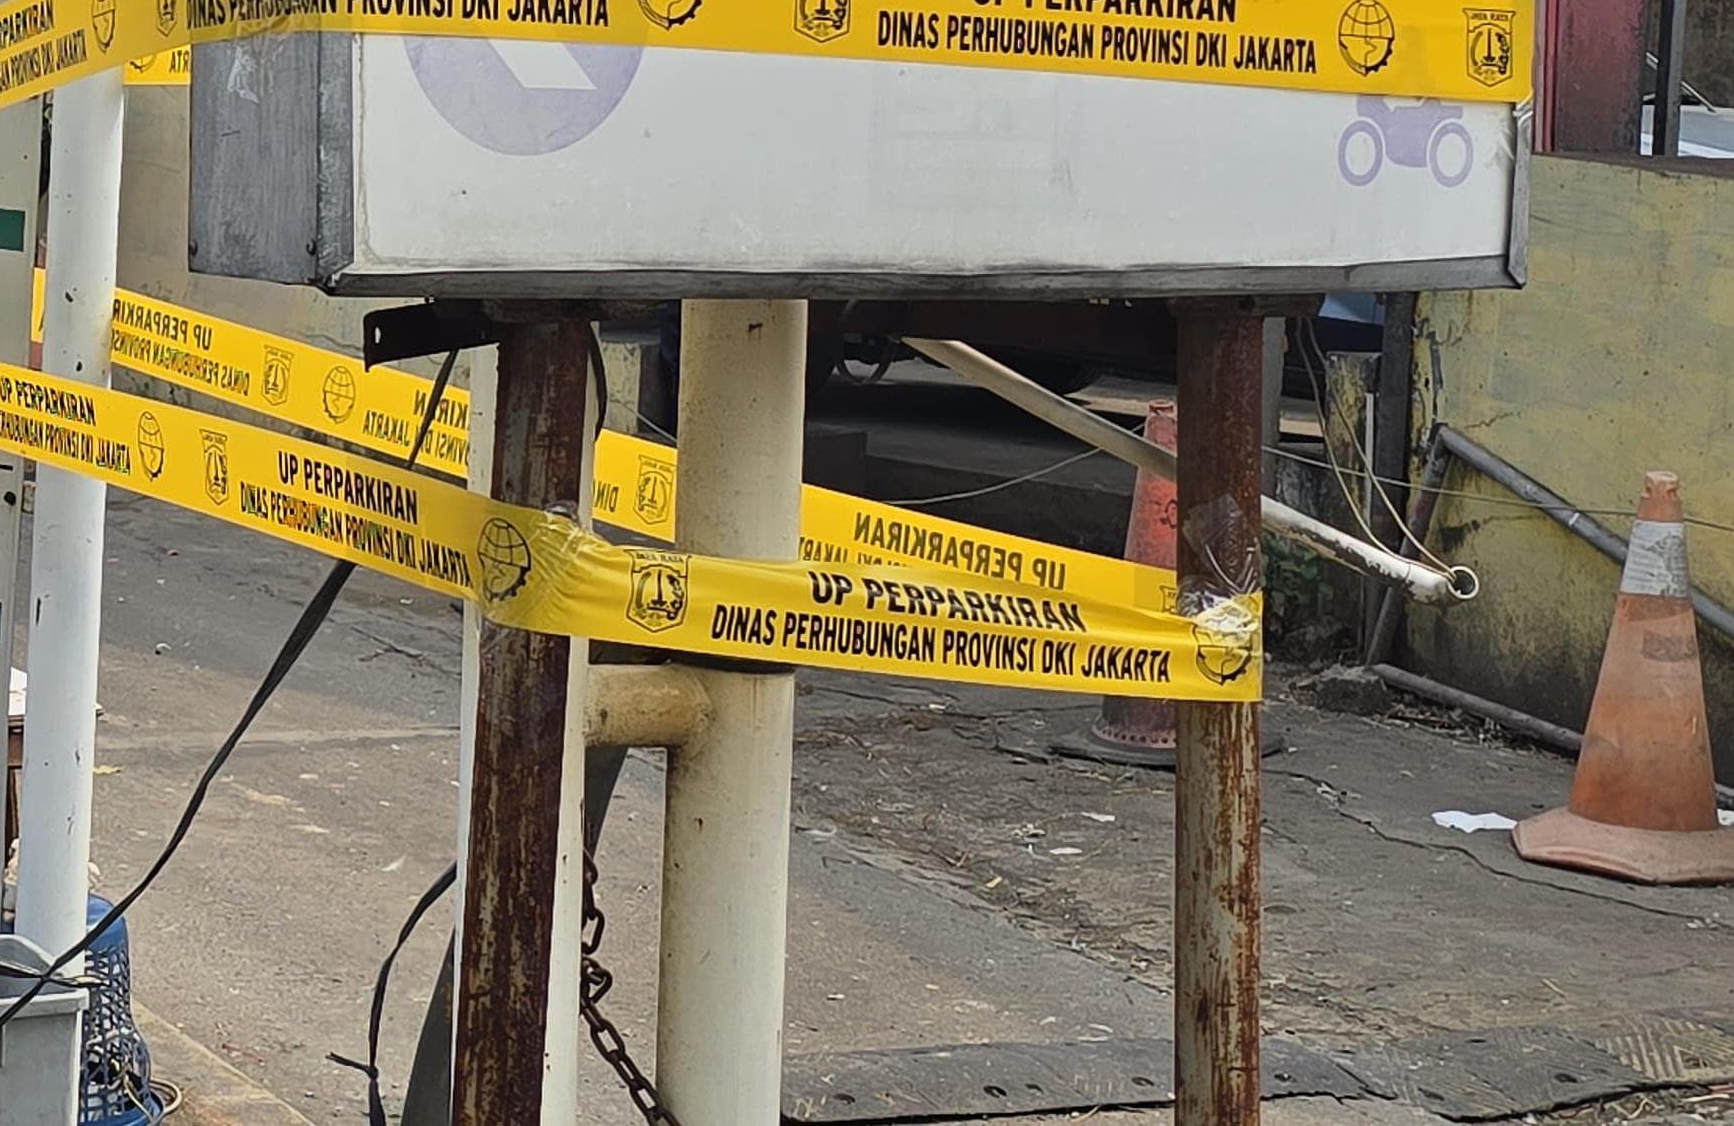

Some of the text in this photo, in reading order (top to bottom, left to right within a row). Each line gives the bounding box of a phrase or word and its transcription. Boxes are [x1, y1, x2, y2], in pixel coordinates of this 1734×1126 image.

[878, 11, 1316, 75] DINAS PERHUBUNGAN PROVINSI DKI JAKARTA
[16, 379, 96, 427] PERPARKIRAN
[96, 435, 131, 477] JAKARTA
[277, 451, 418, 526] UP PERPARKIRAN
[240, 481, 472, 589] DINAS PERHUBUNGAN PROVINSI DKI JAKARTA
[811, 571, 1087, 634] UP PERPARKIRAN
[711, 604, 1171, 684] DINAS PERHUBUNGAN PROVINSI DKI JAKARTA
